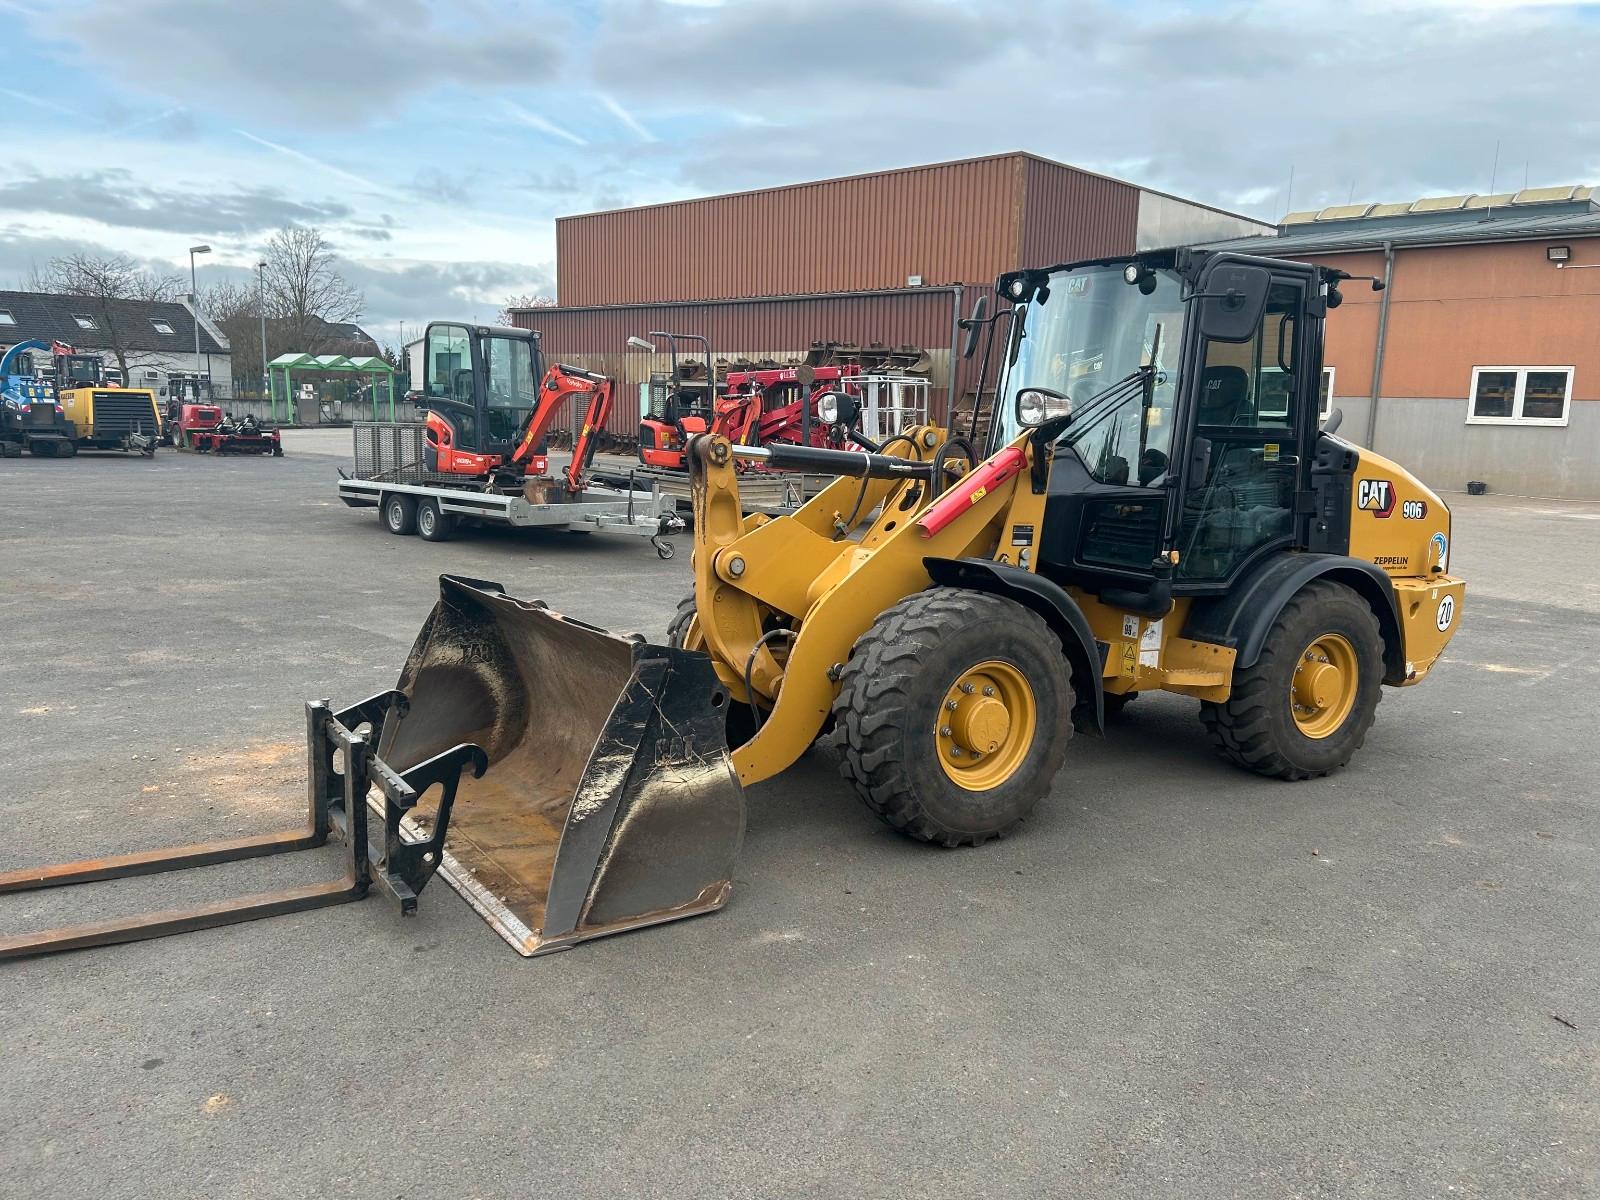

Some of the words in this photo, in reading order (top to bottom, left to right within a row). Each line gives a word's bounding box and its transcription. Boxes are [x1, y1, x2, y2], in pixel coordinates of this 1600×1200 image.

[1207, 379, 1223, 390] CAT
[1358, 480, 1388, 509] CAT
[1403, 501, 1423, 519] 906
[1373, 556, 1409, 565] ZEPPELIN
[1439, 601, 1452, 625] 20
